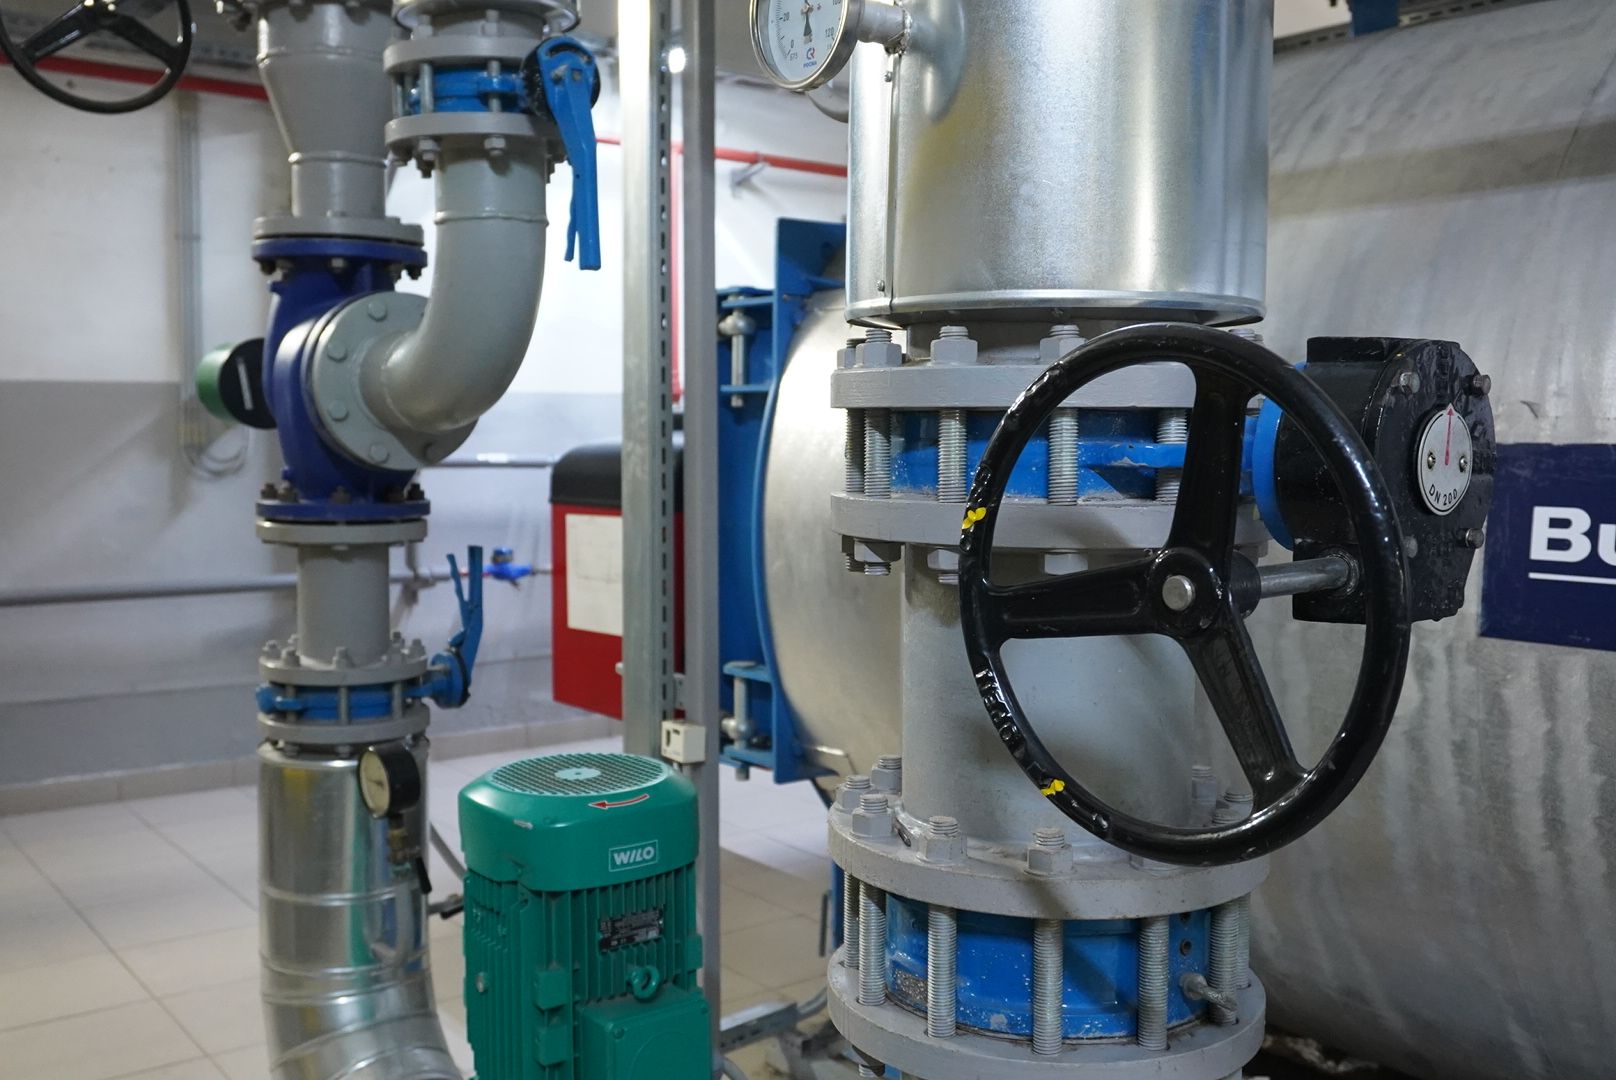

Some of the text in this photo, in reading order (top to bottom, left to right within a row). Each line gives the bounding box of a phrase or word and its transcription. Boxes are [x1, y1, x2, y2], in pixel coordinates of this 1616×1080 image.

[1428, 484, 1459, 506] DN 200
[613, 846, 654, 865] WILO
